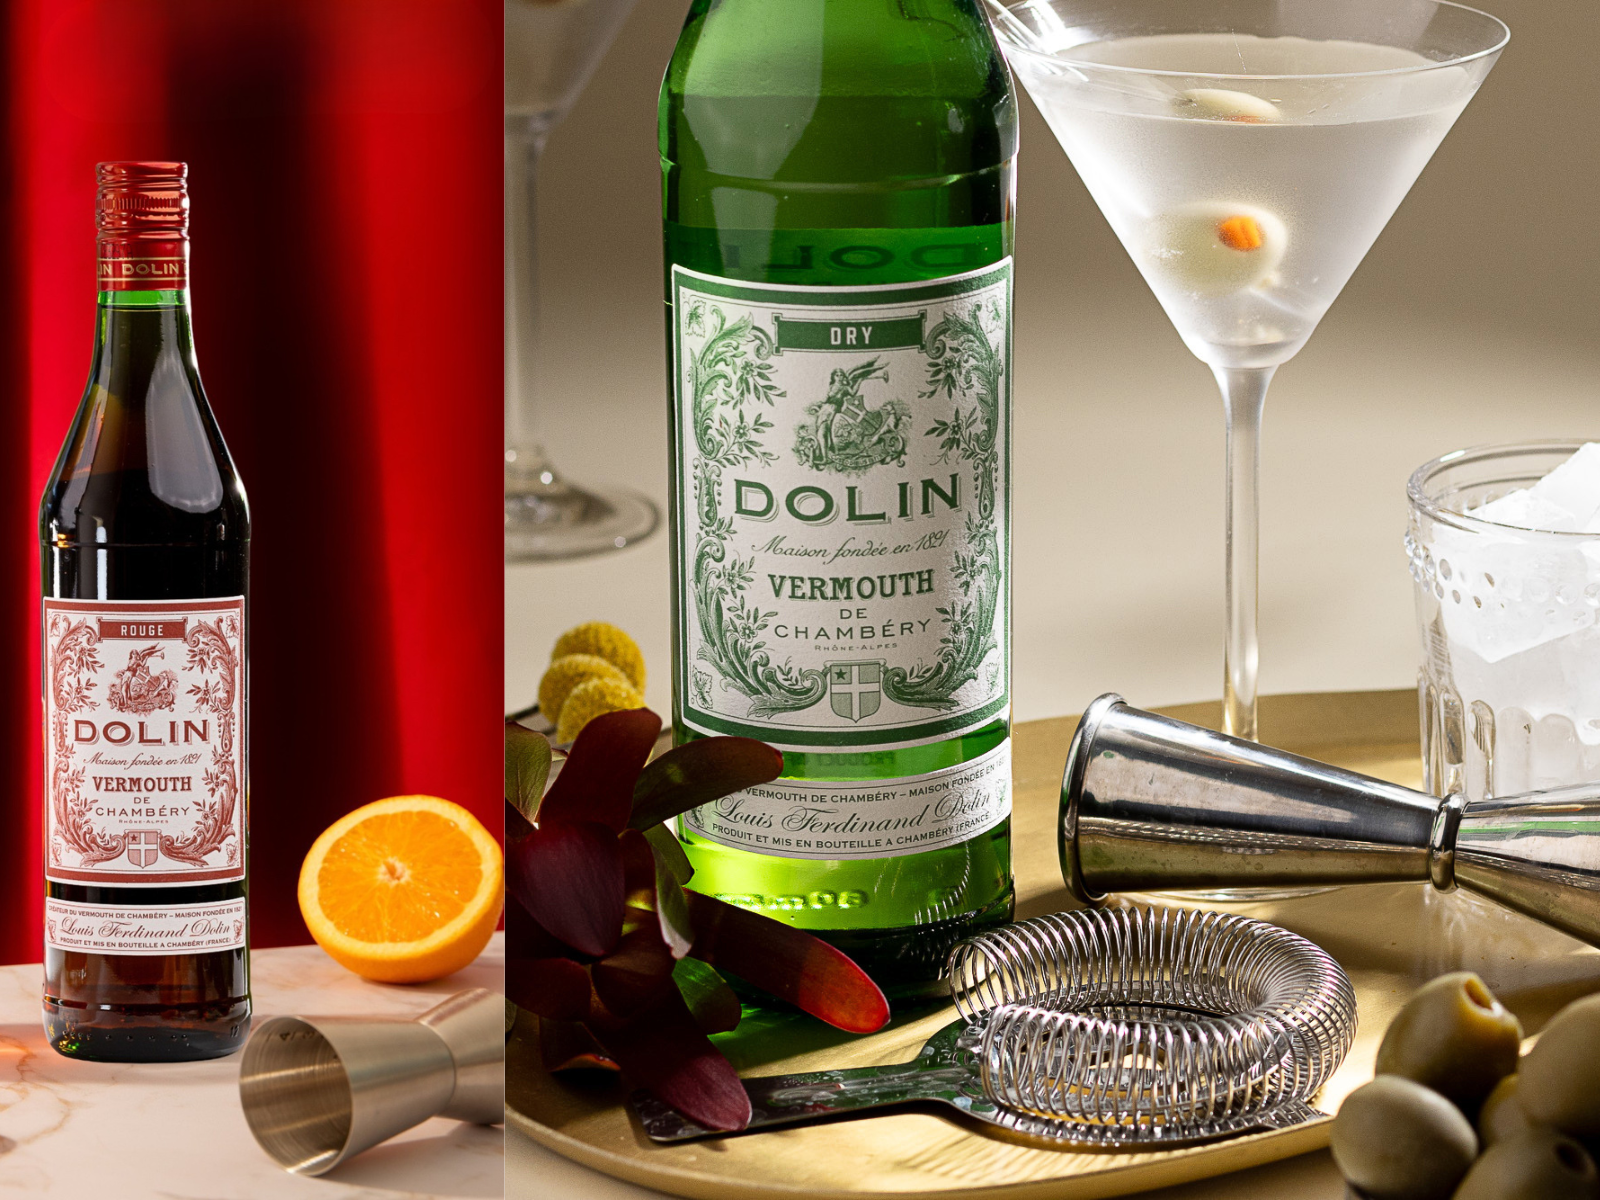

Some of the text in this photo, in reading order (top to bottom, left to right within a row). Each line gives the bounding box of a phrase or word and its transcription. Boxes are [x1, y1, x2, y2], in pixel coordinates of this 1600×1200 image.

[122, 263, 179, 275] DOLIN
[830, 326, 873, 345] DRY
[734, 473, 962, 526] DOLIN
[752, 535, 830, 558] Maison
[823, 536, 887, 566] fondée
[891, 543, 911, 554] en
[767, 568, 935, 602] VERMOUTH
[840, 607, 867, 619] DE
[121, 625, 164, 636] ROUGE
[774, 618, 932, 640] CHAMBÉRY
[74, 719, 210, 747] DOLIN
[83, 752, 129, 765] Maison
[124, 753, 163, 770] fondée
[92, 776, 192, 792] VERMOUTH
[745, 788, 807, 802] VERMOUTH
[811, 794, 827, 803] DE
[830, 791, 897, 803] CHAMBÉRY
[909, 782, 949, 797] MAISON
[951, 768, 984, 788] FONDÉE
[986, 765, 995, 775] EN
[95, 805, 190, 817] CHAMBÉRY
[712, 786, 991, 833] Louis Ferdinand Dolin
[712, 823, 752, 841] PRODUIT
[756, 835, 769, 844] ET
[772, 837, 792, 847] MIS
[796, 839, 812, 848] EN
[816, 839, 882, 849] BOUTEILLE
[885, 838, 893, 846] A
[896, 825, 953, 844] CHAMBÉRY
[78, 910, 114, 918] VERMOUTH
[203, 908, 225, 916] FONDÉE
[60, 916, 230, 938] Louis Ferdinand Dolin
[60, 937, 82, 945] PRODUIT
[167, 940, 204, 948] CHAMBÉRY
